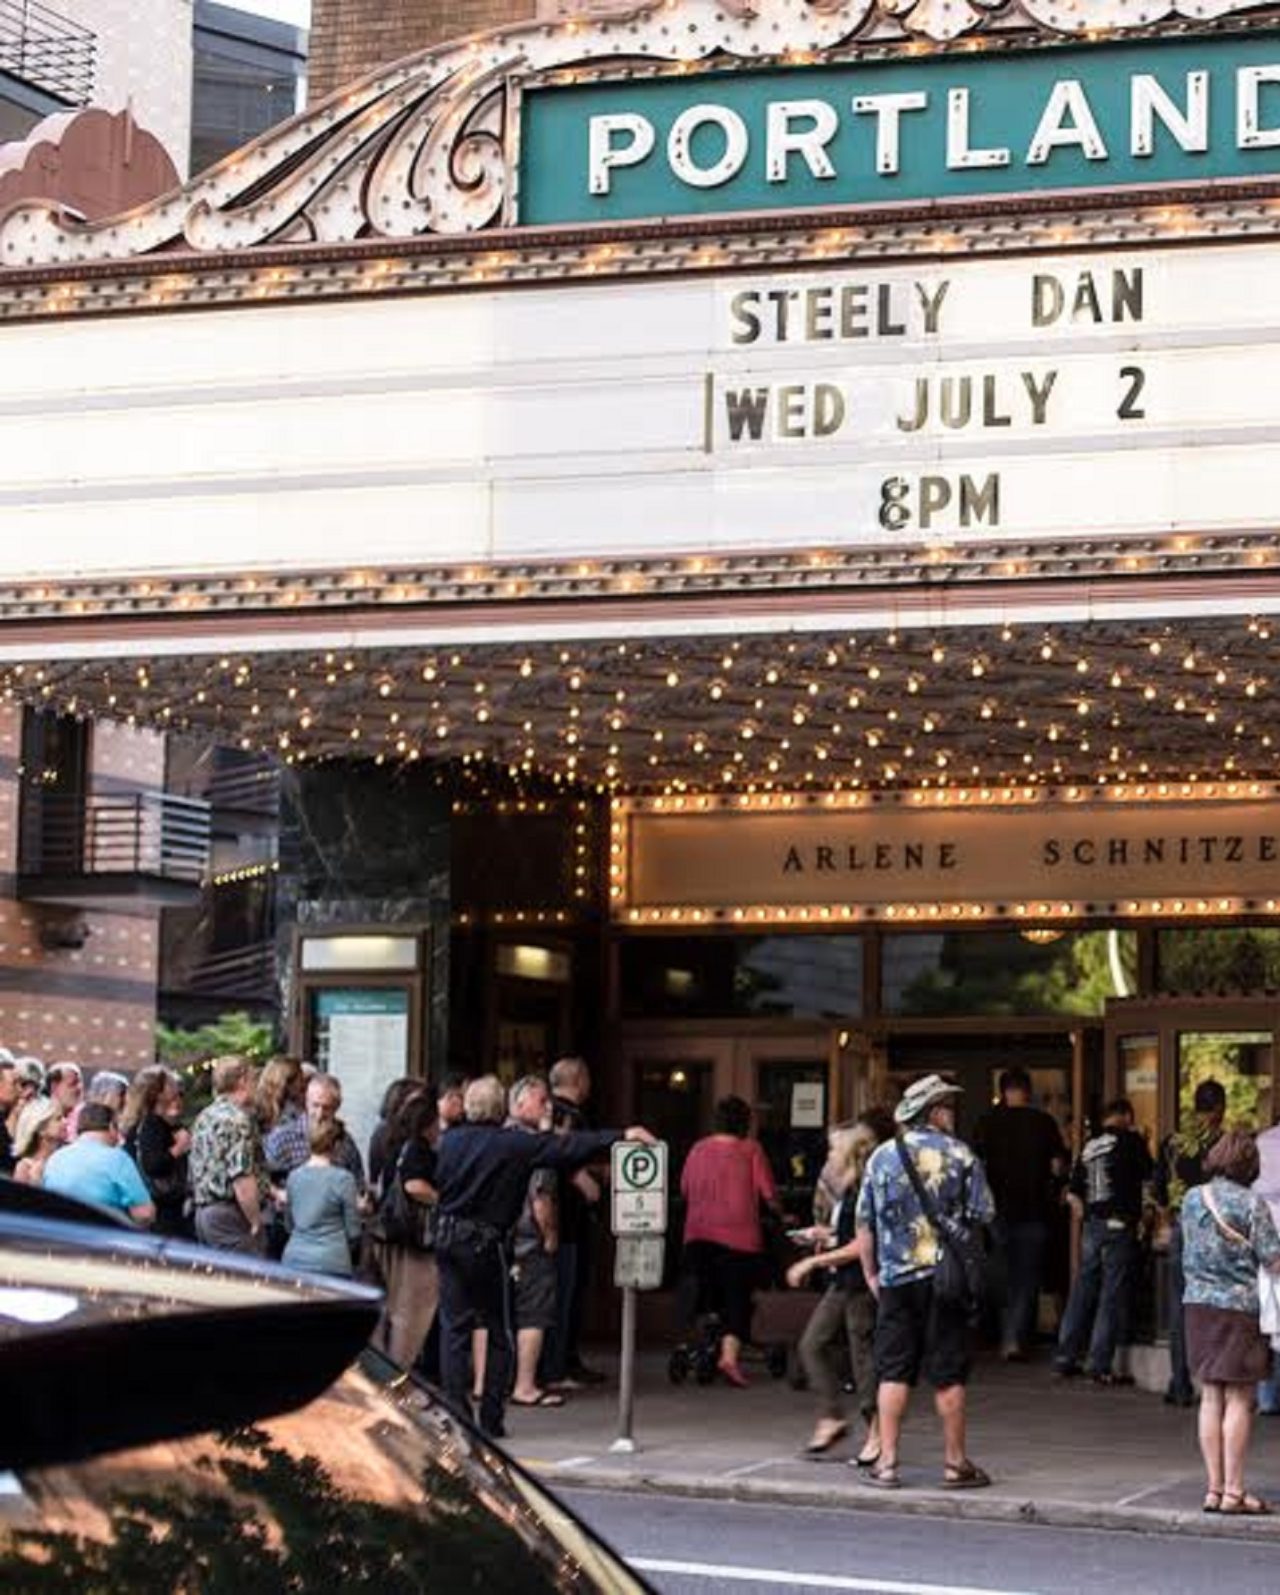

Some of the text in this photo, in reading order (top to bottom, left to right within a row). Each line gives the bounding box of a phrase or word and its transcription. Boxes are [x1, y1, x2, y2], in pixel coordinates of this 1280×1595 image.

[730, 267, 1144, 344] STEELY DAN
[725, 366, 1147, 441] WED JULY 2
[879, 472, 1001, 531] 8PM
[783, 843, 957, 872] ARLENE
